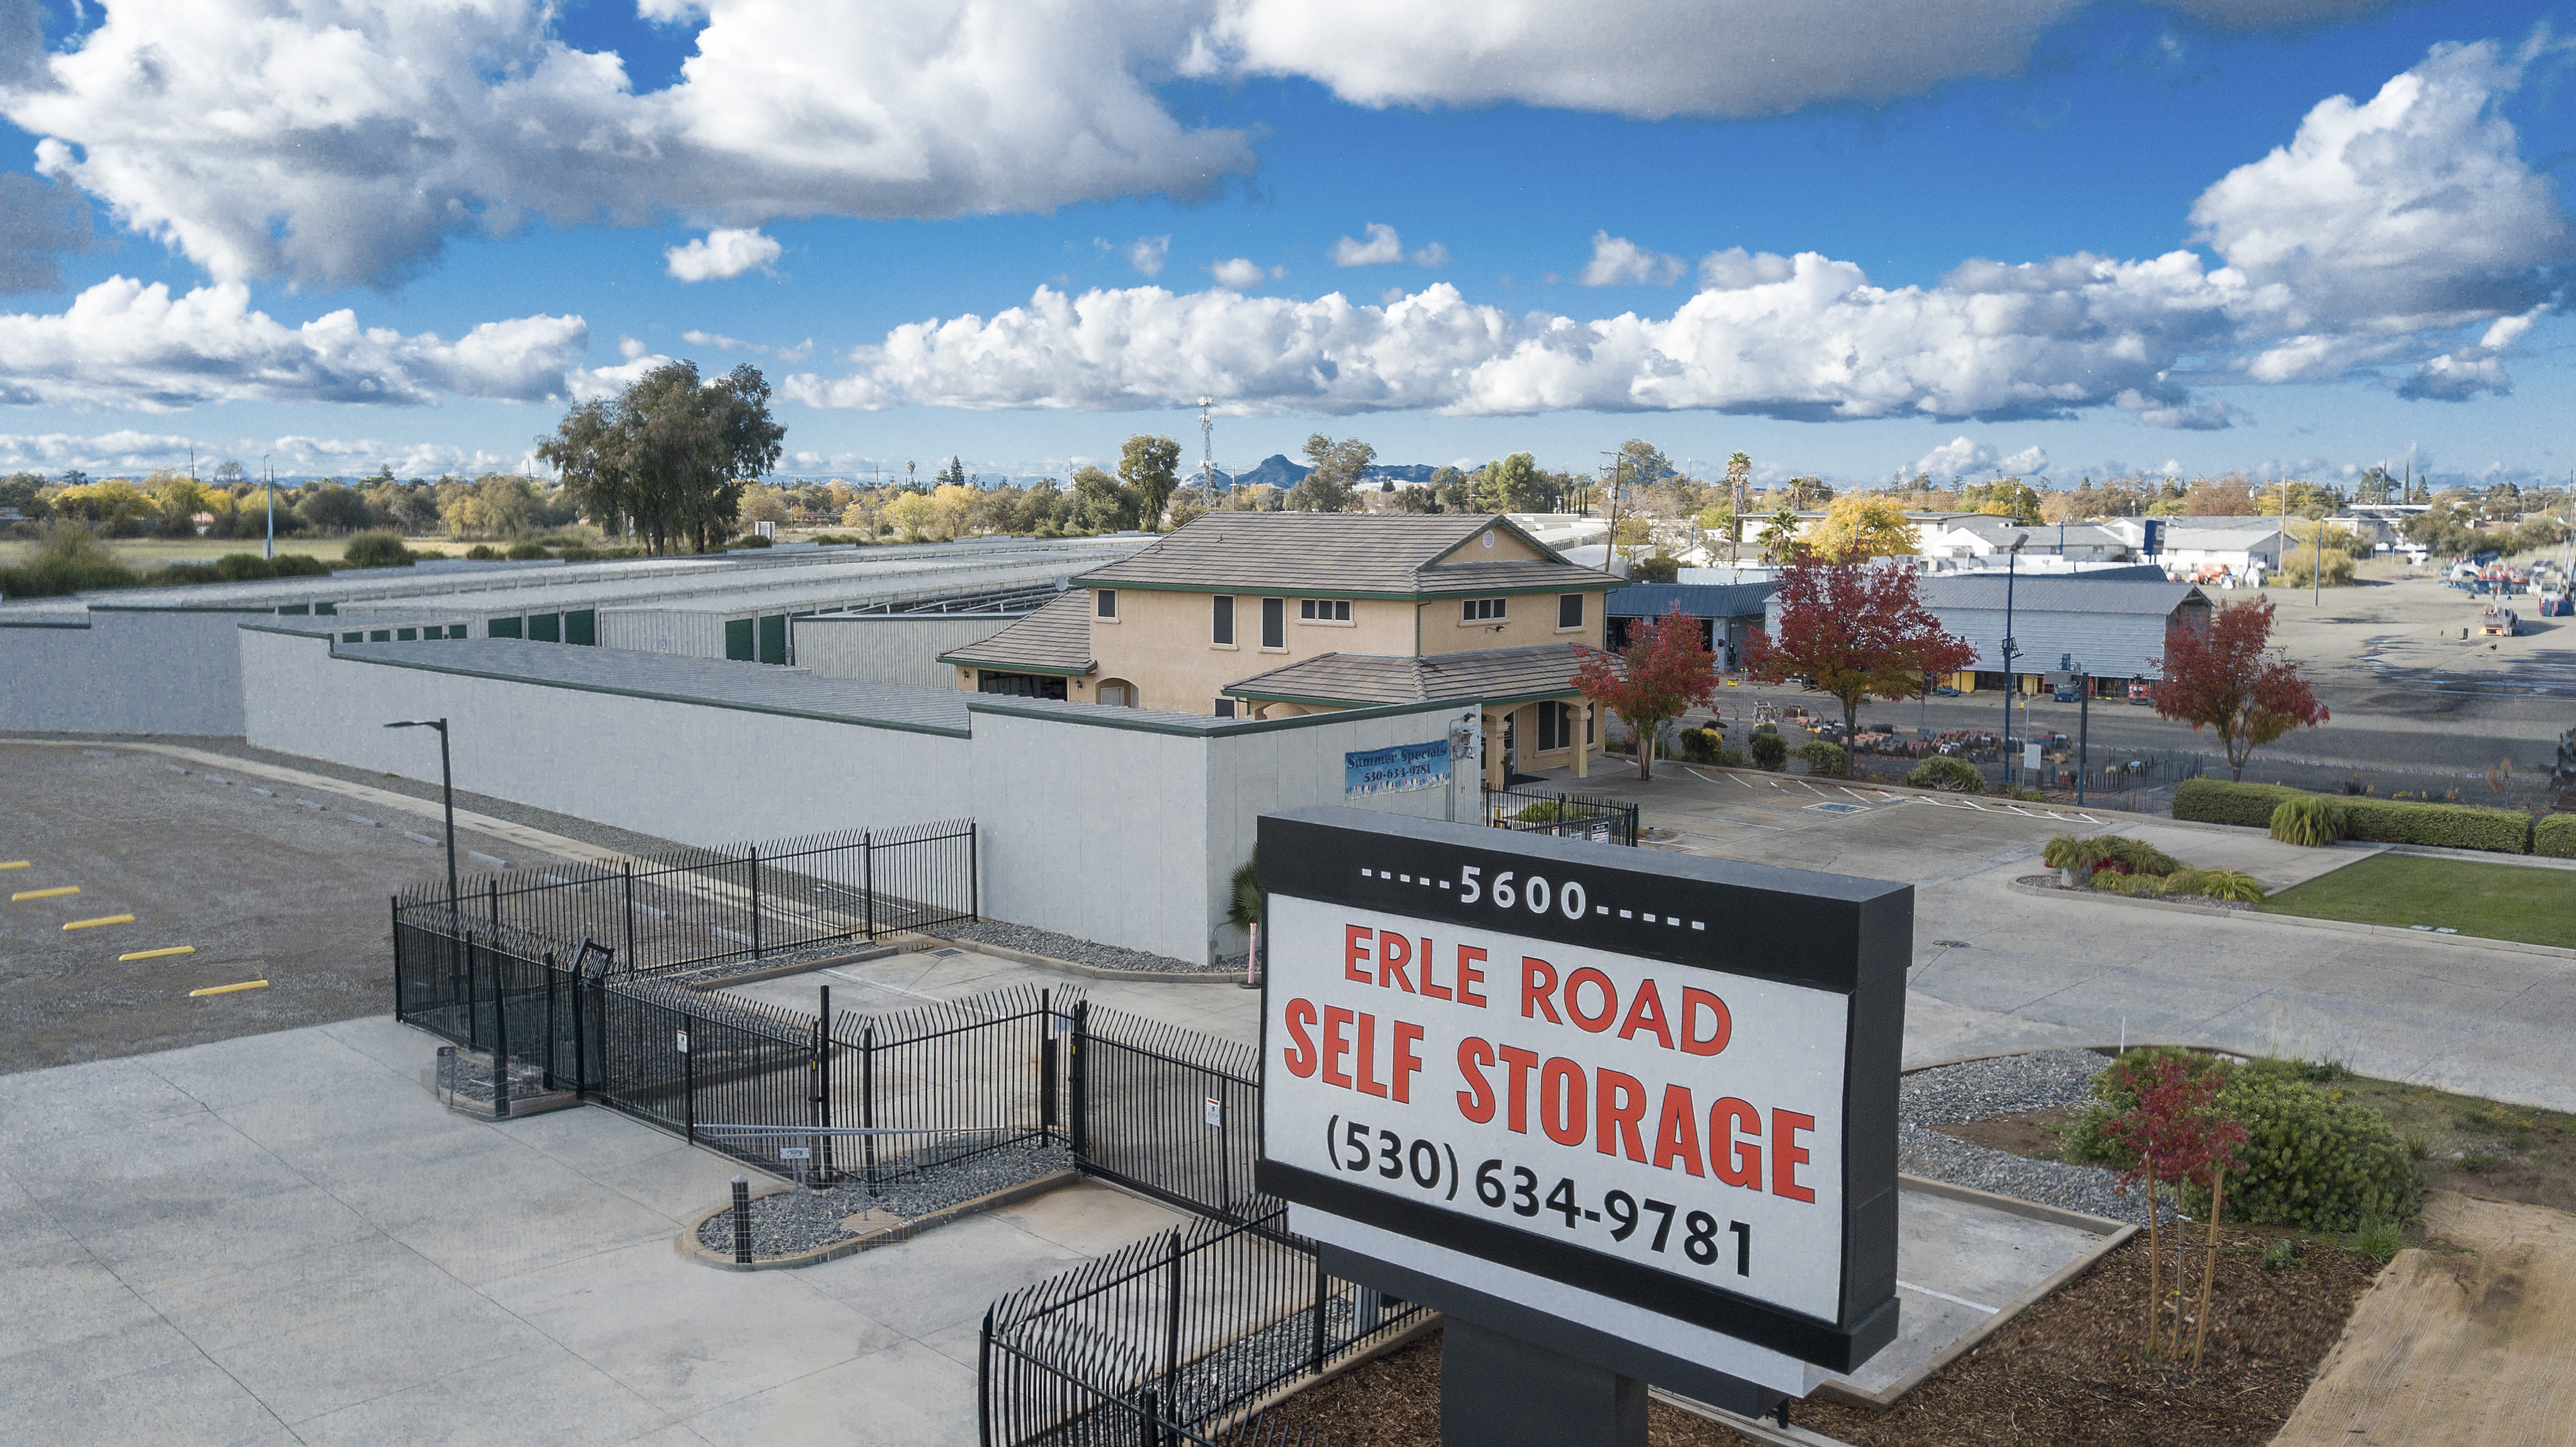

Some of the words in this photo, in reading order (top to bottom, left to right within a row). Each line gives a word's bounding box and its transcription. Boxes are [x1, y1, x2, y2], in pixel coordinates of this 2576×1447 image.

[1347, 753, 1397, 769] Summer
[1401, 745, 1447, 764] Specials
[1363, 764, 1431, 783] 530-634-9781
[1345, 924, 1487, 1008] ERLE
[1521, 956, 1732, 1057] ROAD
[1283, 998, 1424, 1104] SELF
[1456, 1036, 1815, 1204] STORAGE
[1327, 1114, 1458, 1201] (530)
[1476, 1159, 1751, 1278] 634-9781
